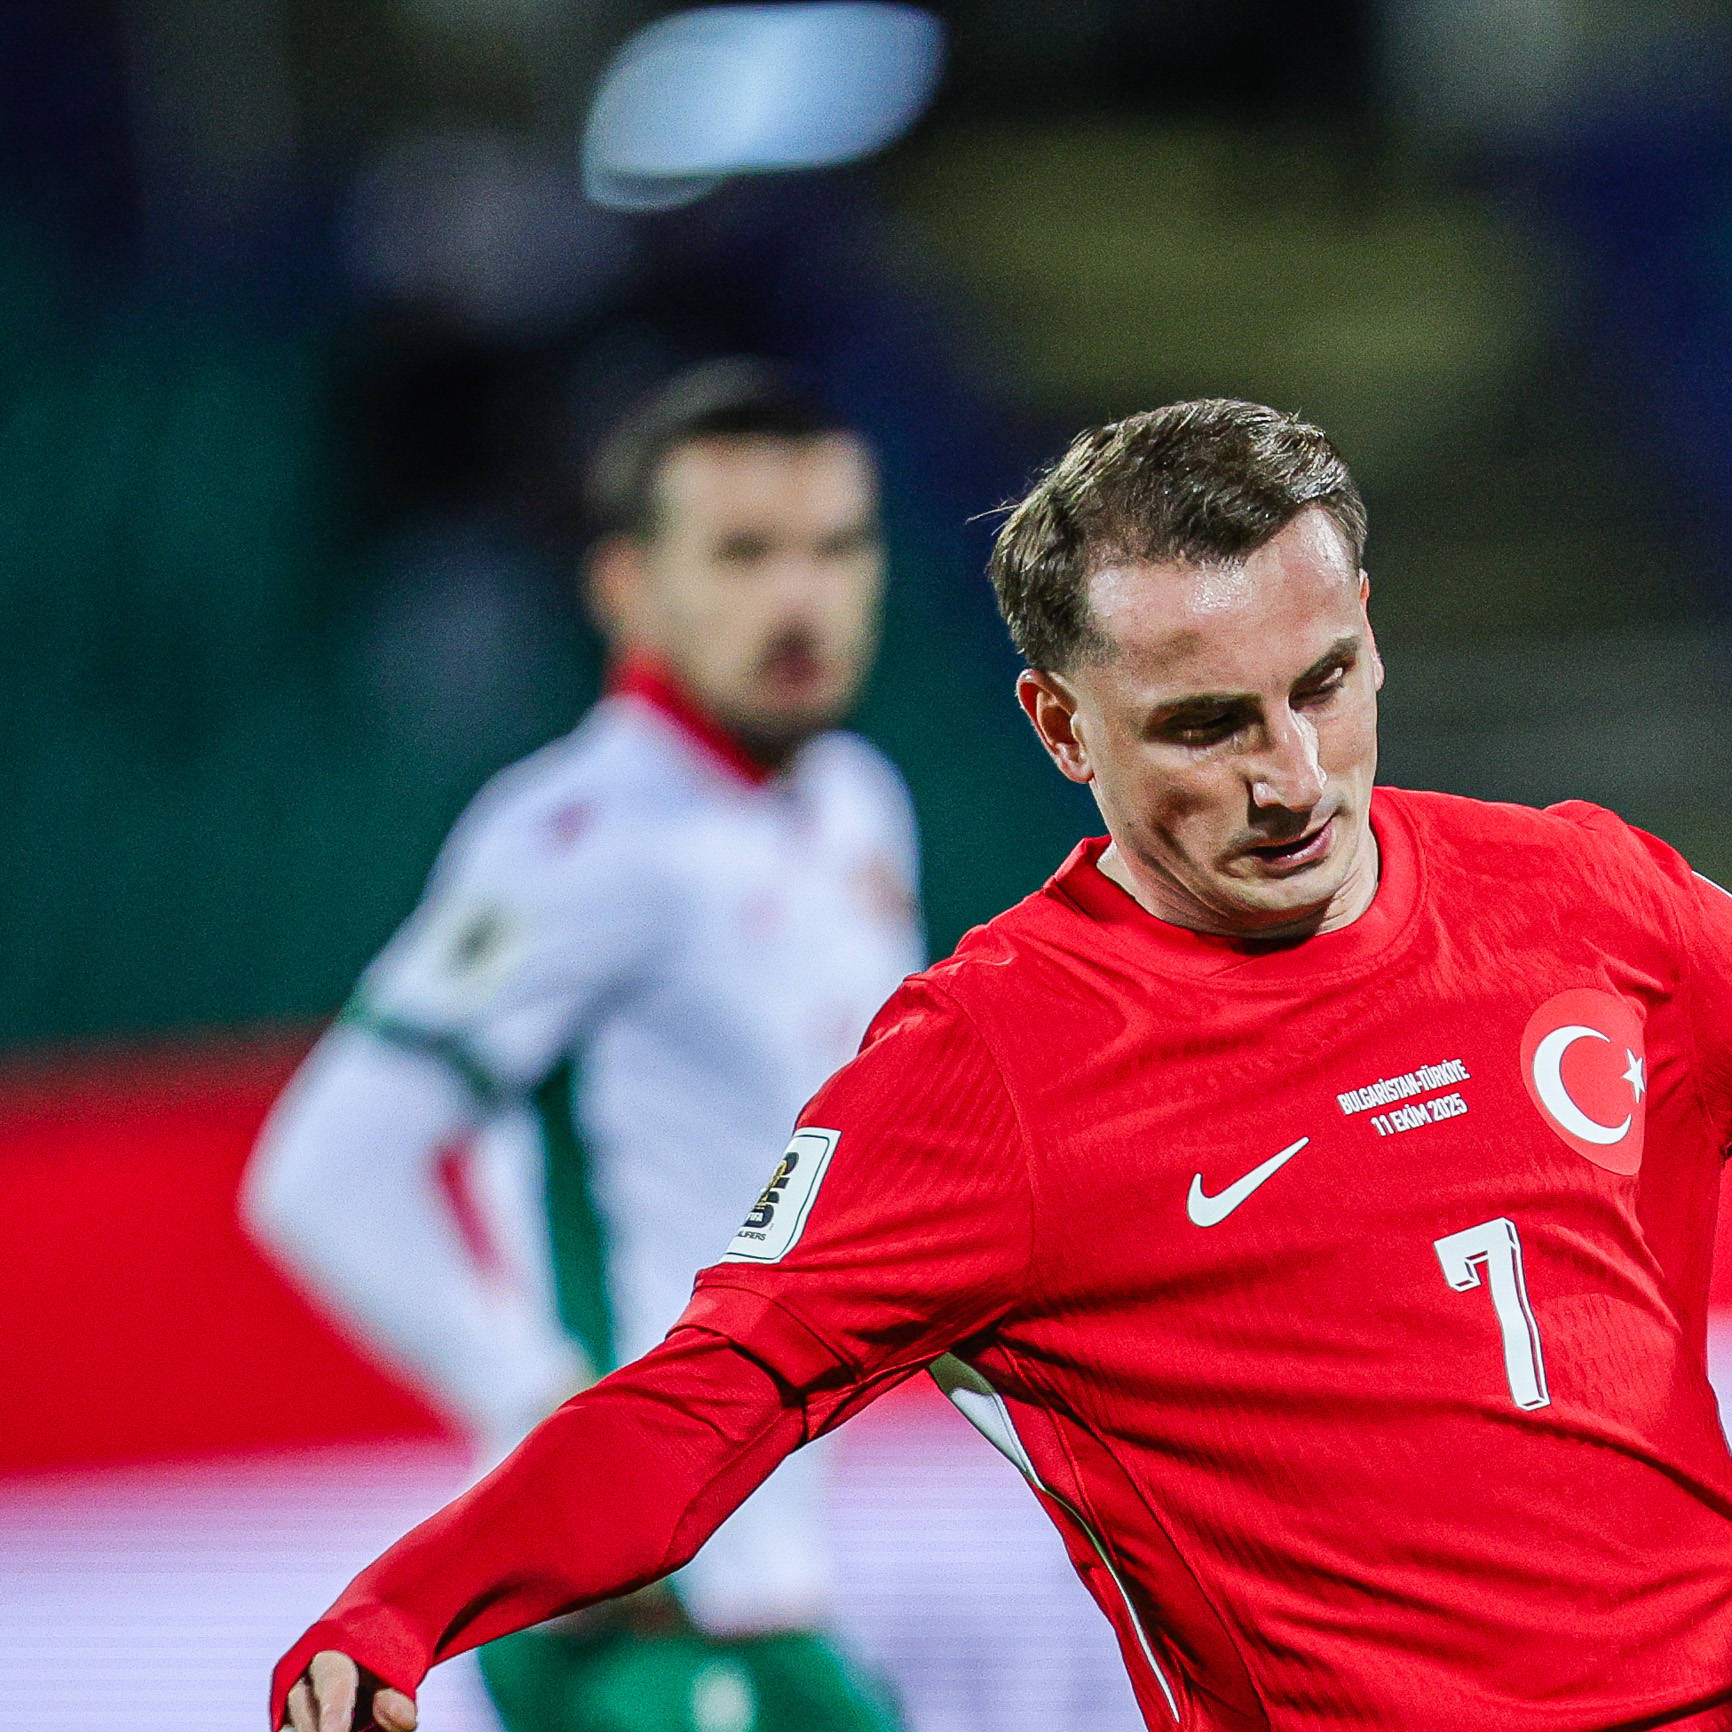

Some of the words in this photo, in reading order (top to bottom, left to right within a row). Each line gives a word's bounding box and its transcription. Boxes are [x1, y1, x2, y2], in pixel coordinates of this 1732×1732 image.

[1370, 1114, 1394, 1136] 11
[1389, 1104, 1432, 1132] EKİM
[1427, 1092, 1468, 1121] 2025
[1434, 1217, 1551, 1411] 7
